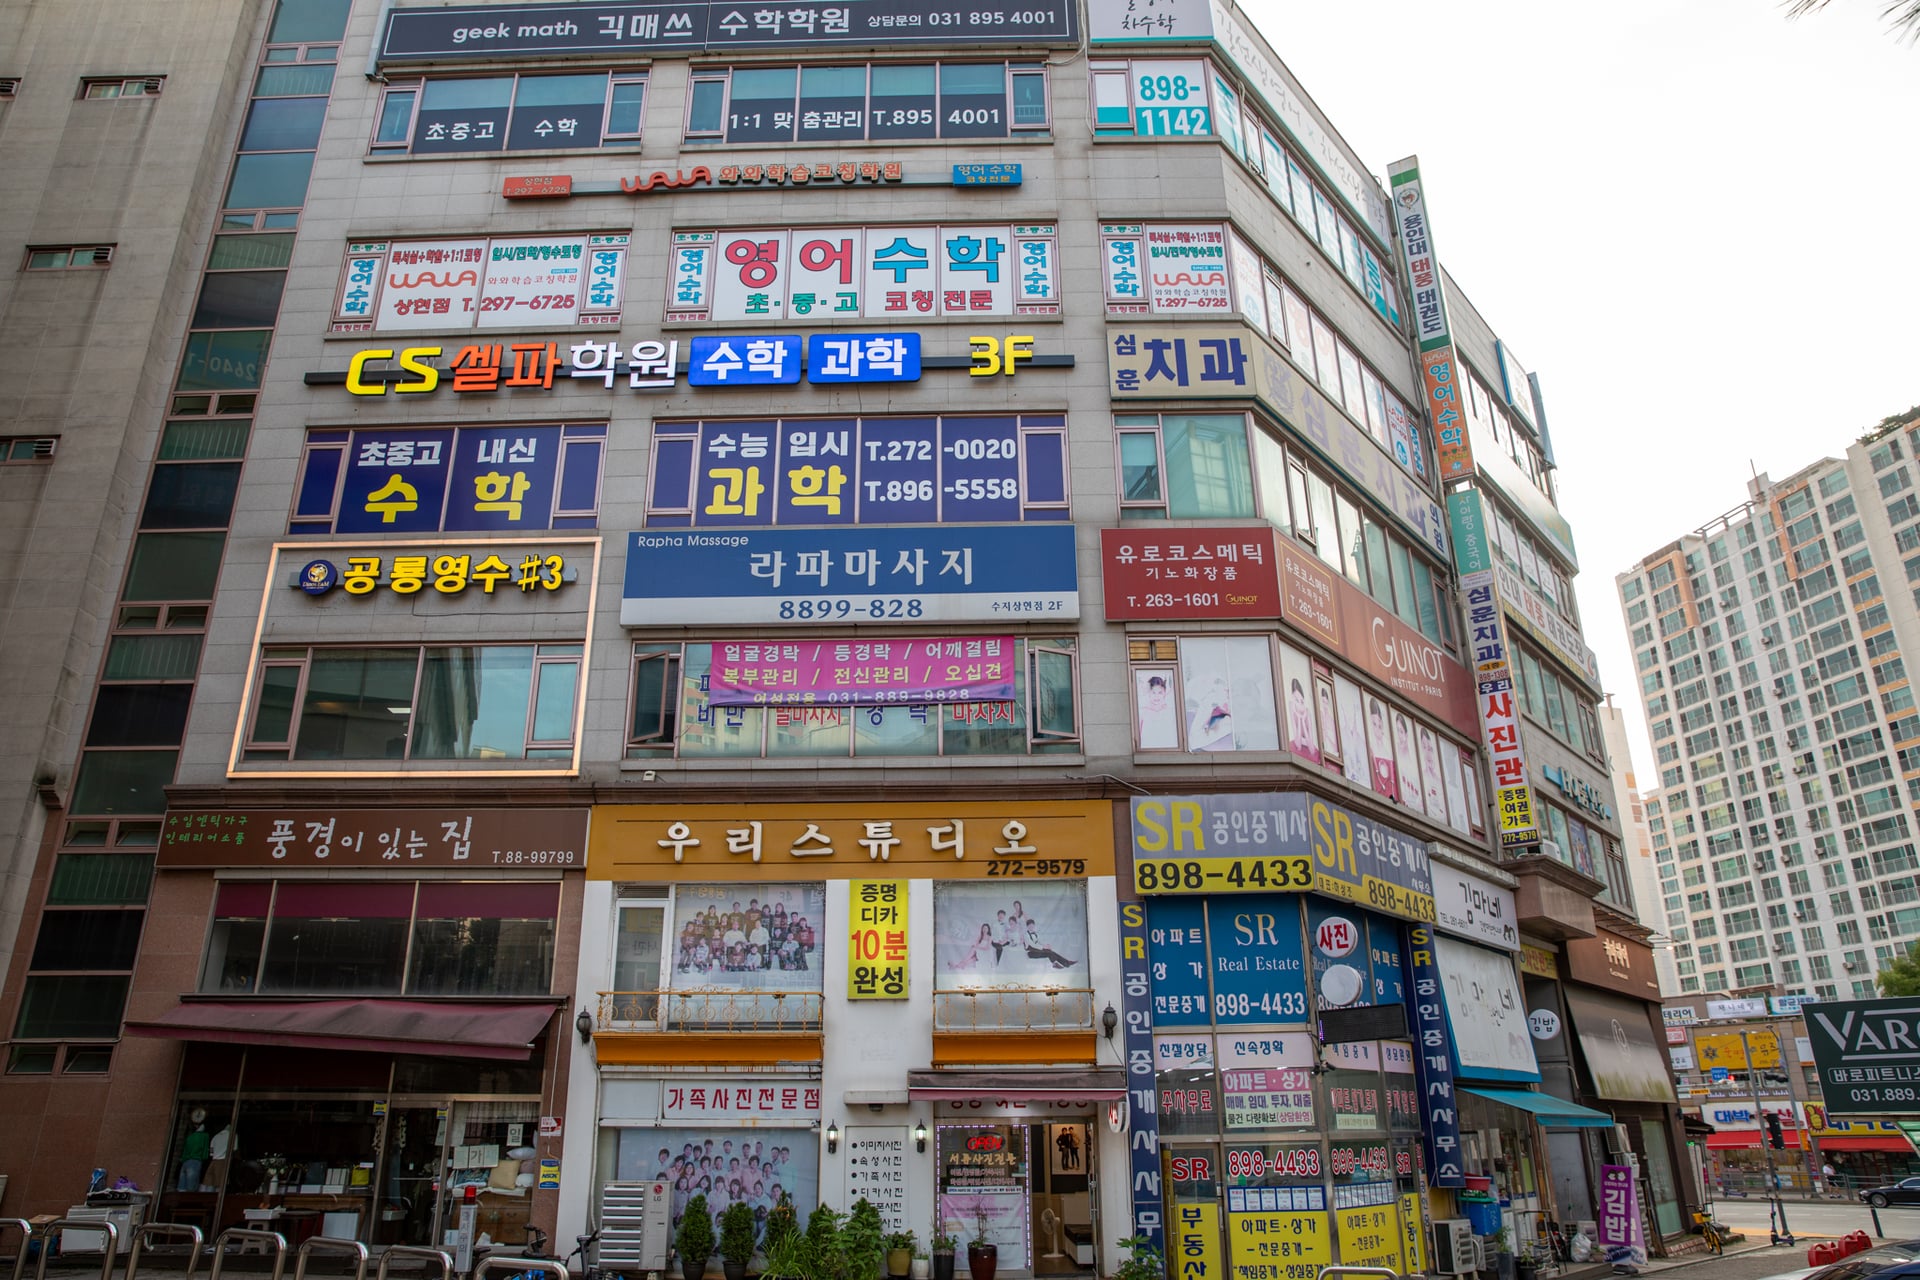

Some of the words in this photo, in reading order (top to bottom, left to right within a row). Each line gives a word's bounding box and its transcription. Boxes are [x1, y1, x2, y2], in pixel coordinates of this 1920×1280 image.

[453, 22, 510, 43] geek
[517, 20, 578, 38] math
[598, 13, 693, 39] 긱매쓰
[719, 7, 850, 37] 수학학원
[867, 13, 922, 27] 상담문의
[928, 12, 963, 26] 031
[969, 11, 1004, 25] 895
[1010, 10, 1056, 25] 4001
[1121, 13, 1177, 35] 차수학
[1140, 75, 1200, 101] 898-
[533, 118, 579, 137] 수학
[730, 113, 761, 129] 1:1
[873, 108, 933, 127] T.895
[948, 108, 1001, 126] 4001
[1142, 108, 1208, 136] 1142
[718, 161, 902, 186] 와와학습코칭학원
[1403, 213, 1428, 257] 용인대
[1416, 288, 1442, 335] 태권도
[393, 297, 451, 316] 상현점
[1155, 297, 1229, 308] T.297-6725
[345, 346, 443, 396] CS
[702, 338, 789, 381] 수학
[820, 337, 908, 378] 과학
[968, 335, 1035, 378] 3F
[1143, 337, 1248, 387] 치과
[357, 440, 443, 467] 초중고
[476, 438, 537, 464] 내신
[708, 433, 769, 459] 수능
[789, 430, 849, 457] 입시
[638, 534, 684, 550] Rapha
[687, 533, 750, 548] Massage
[1115, 543, 1263, 565] 유로코스메틱
[1464, 534, 1482, 570] 중국어
[748, 547, 974, 589] 라파마사지
[779, 598, 924, 621] 8899-828
[990, 600, 1044, 613] 수지상현점
[1048, 600, 1064, 612] 2F
[1145, 592, 1220, 608] 263-1601
[1298, 598, 1333, 632] 263-1601
[1467, 586, 1504, 662] 심훈치과
[724, 644, 800, 662] 얼굴경락
[834, 642, 891, 660] 등경락
[925, 639, 1002, 659] 어깨결림
[1372, 616, 1445, 683] GUINOT
[722, 667, 798, 686] 복부관리
[834, 666, 910, 685] 전신관리
[944, 661, 1002, 681] 오십견
[754, 691, 817, 704] 여성전용
[828, 688, 970, 704] 031-889-9828
[1480, 679, 1510, 694] 우리
[1485, 691, 1524, 787] 사진관
[266, 817, 364, 859] 풍경이
[378, 827, 428, 860] 있는
[440, 815, 473, 861] 집
[1135, 800, 1206, 853] SR
[1211, 808, 1307, 846] 공인중개사
[1311, 801, 1359, 877] SR
[1355, 820, 1429, 878] 공인중개사
[491, 850, 575, 866] T.88-99799
[986, 858, 1086, 876] 272-9579
[1138, 858, 1313, 891] 898-4433
[860, 882, 898, 902] 증명
[1368, 879, 1437, 923] 898-4433
[861, 905, 899, 925] 디카
[1151, 926, 1203, 947] 아파트
[1233, 912, 1279, 947] SR
[1319, 922, 1350, 951] 사진
[850, 929, 909, 962] 10분
[1372, 947, 1400, 968] 아파트
[1217, 955, 1249, 972] Real
[1255, 955, 1300, 972] Estate
[853, 966, 905, 995] 완성
[1155, 994, 1206, 1015] 전문중개
[1215, 991, 1306, 1017] 898-4433
[1529, 1016, 1556, 1033] 김밥
[1813, 1009, 1920, 1052] VAR
[1159, 1042, 1208, 1059] 친절상담
[1233, 1039, 1284, 1056] 신속정확
[1224, 1071, 1268, 1092] 아파트
[1280, 1070, 1310, 1091] 상가
[667, 1086, 821, 1111] 가족사진전문점
[1161, 1089, 1213, 1116] 주차무료
[860, 1140, 902, 1151] 이미지사진
[967, 1135, 1004, 1151] OPEN
[860, 1156, 902, 1166] 속성사진
[1171, 1157, 1210, 1182] SR
[1228, 1148, 1321, 1177] 898-4433
[1331, 1146, 1389, 1176] 898-4433
[1395, 1151, 1412, 1176] SR
[860, 1171, 902, 1182] 가족사진
[860, 1187, 903, 1198] 디카사진
[1604, 1188, 1629, 1243] 김밥
